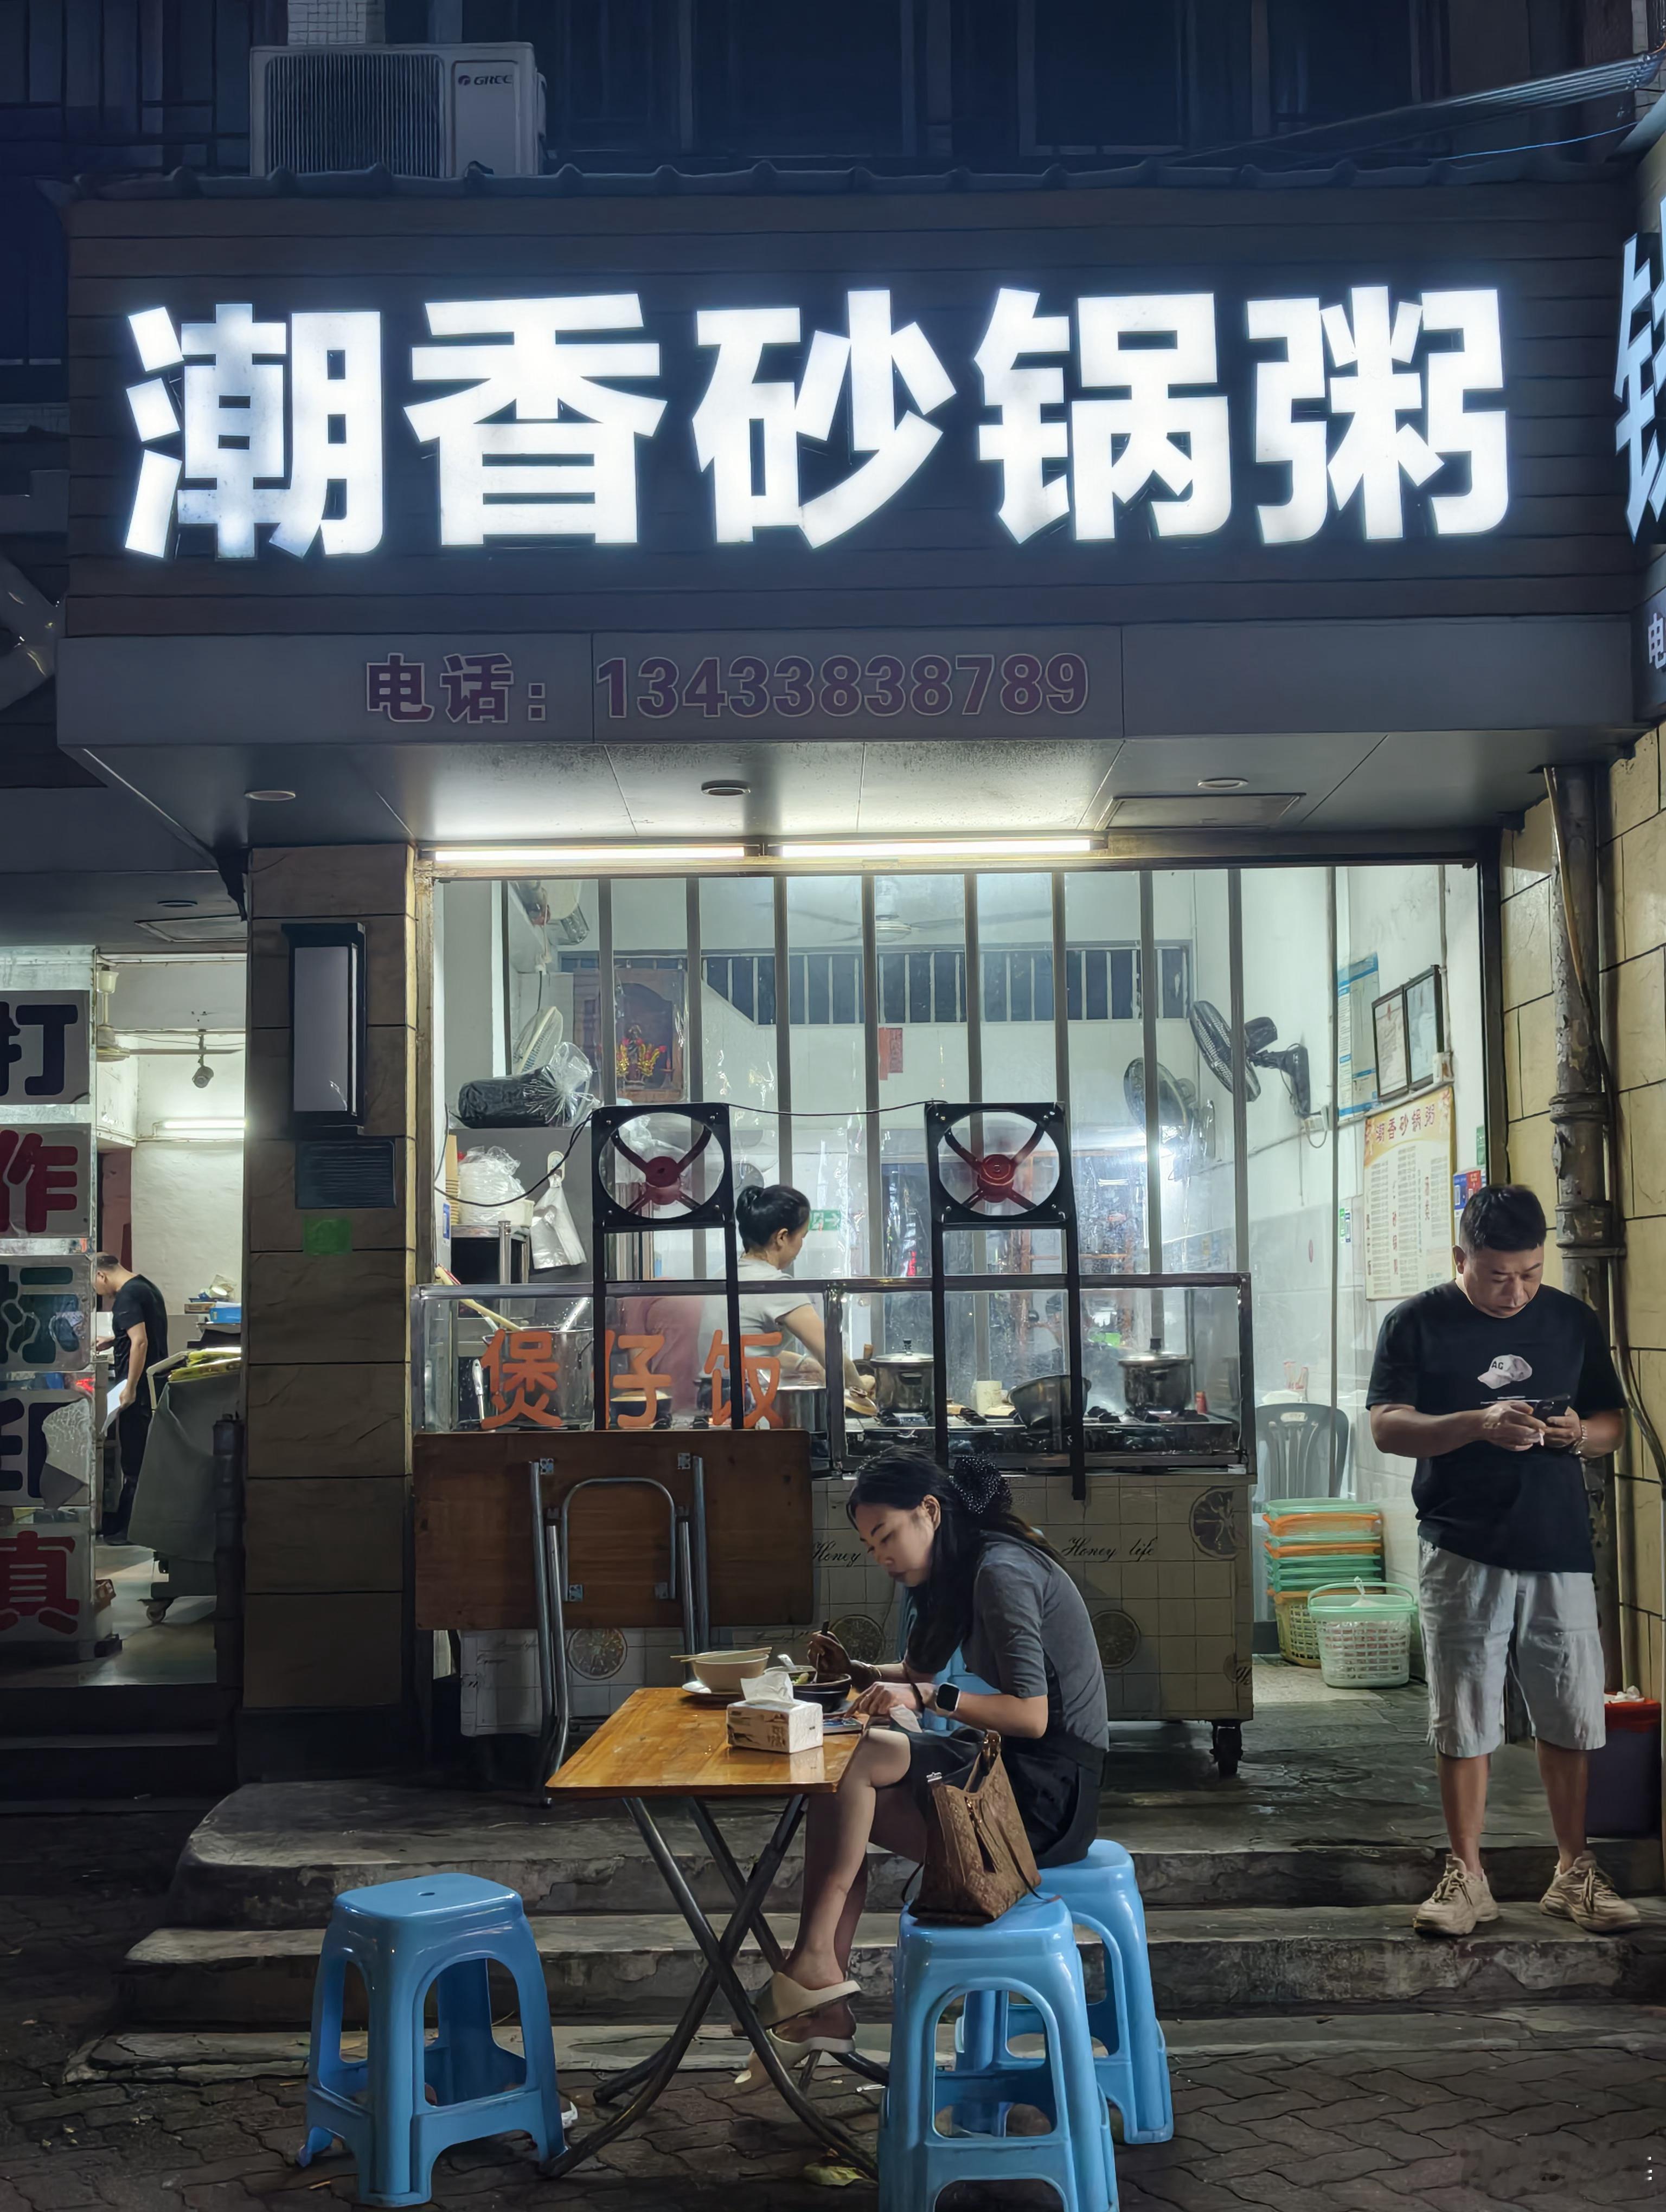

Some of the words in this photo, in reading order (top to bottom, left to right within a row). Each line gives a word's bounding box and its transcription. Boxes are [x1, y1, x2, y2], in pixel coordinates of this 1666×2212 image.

[125, 286, 1510, 562] 潮香砂锅粥
[595, 653, 1087, 719] 13433838789
[481, 1328, 783, 1430] 煲仔饭
[1061, 1536, 1118, 1562] Honey
